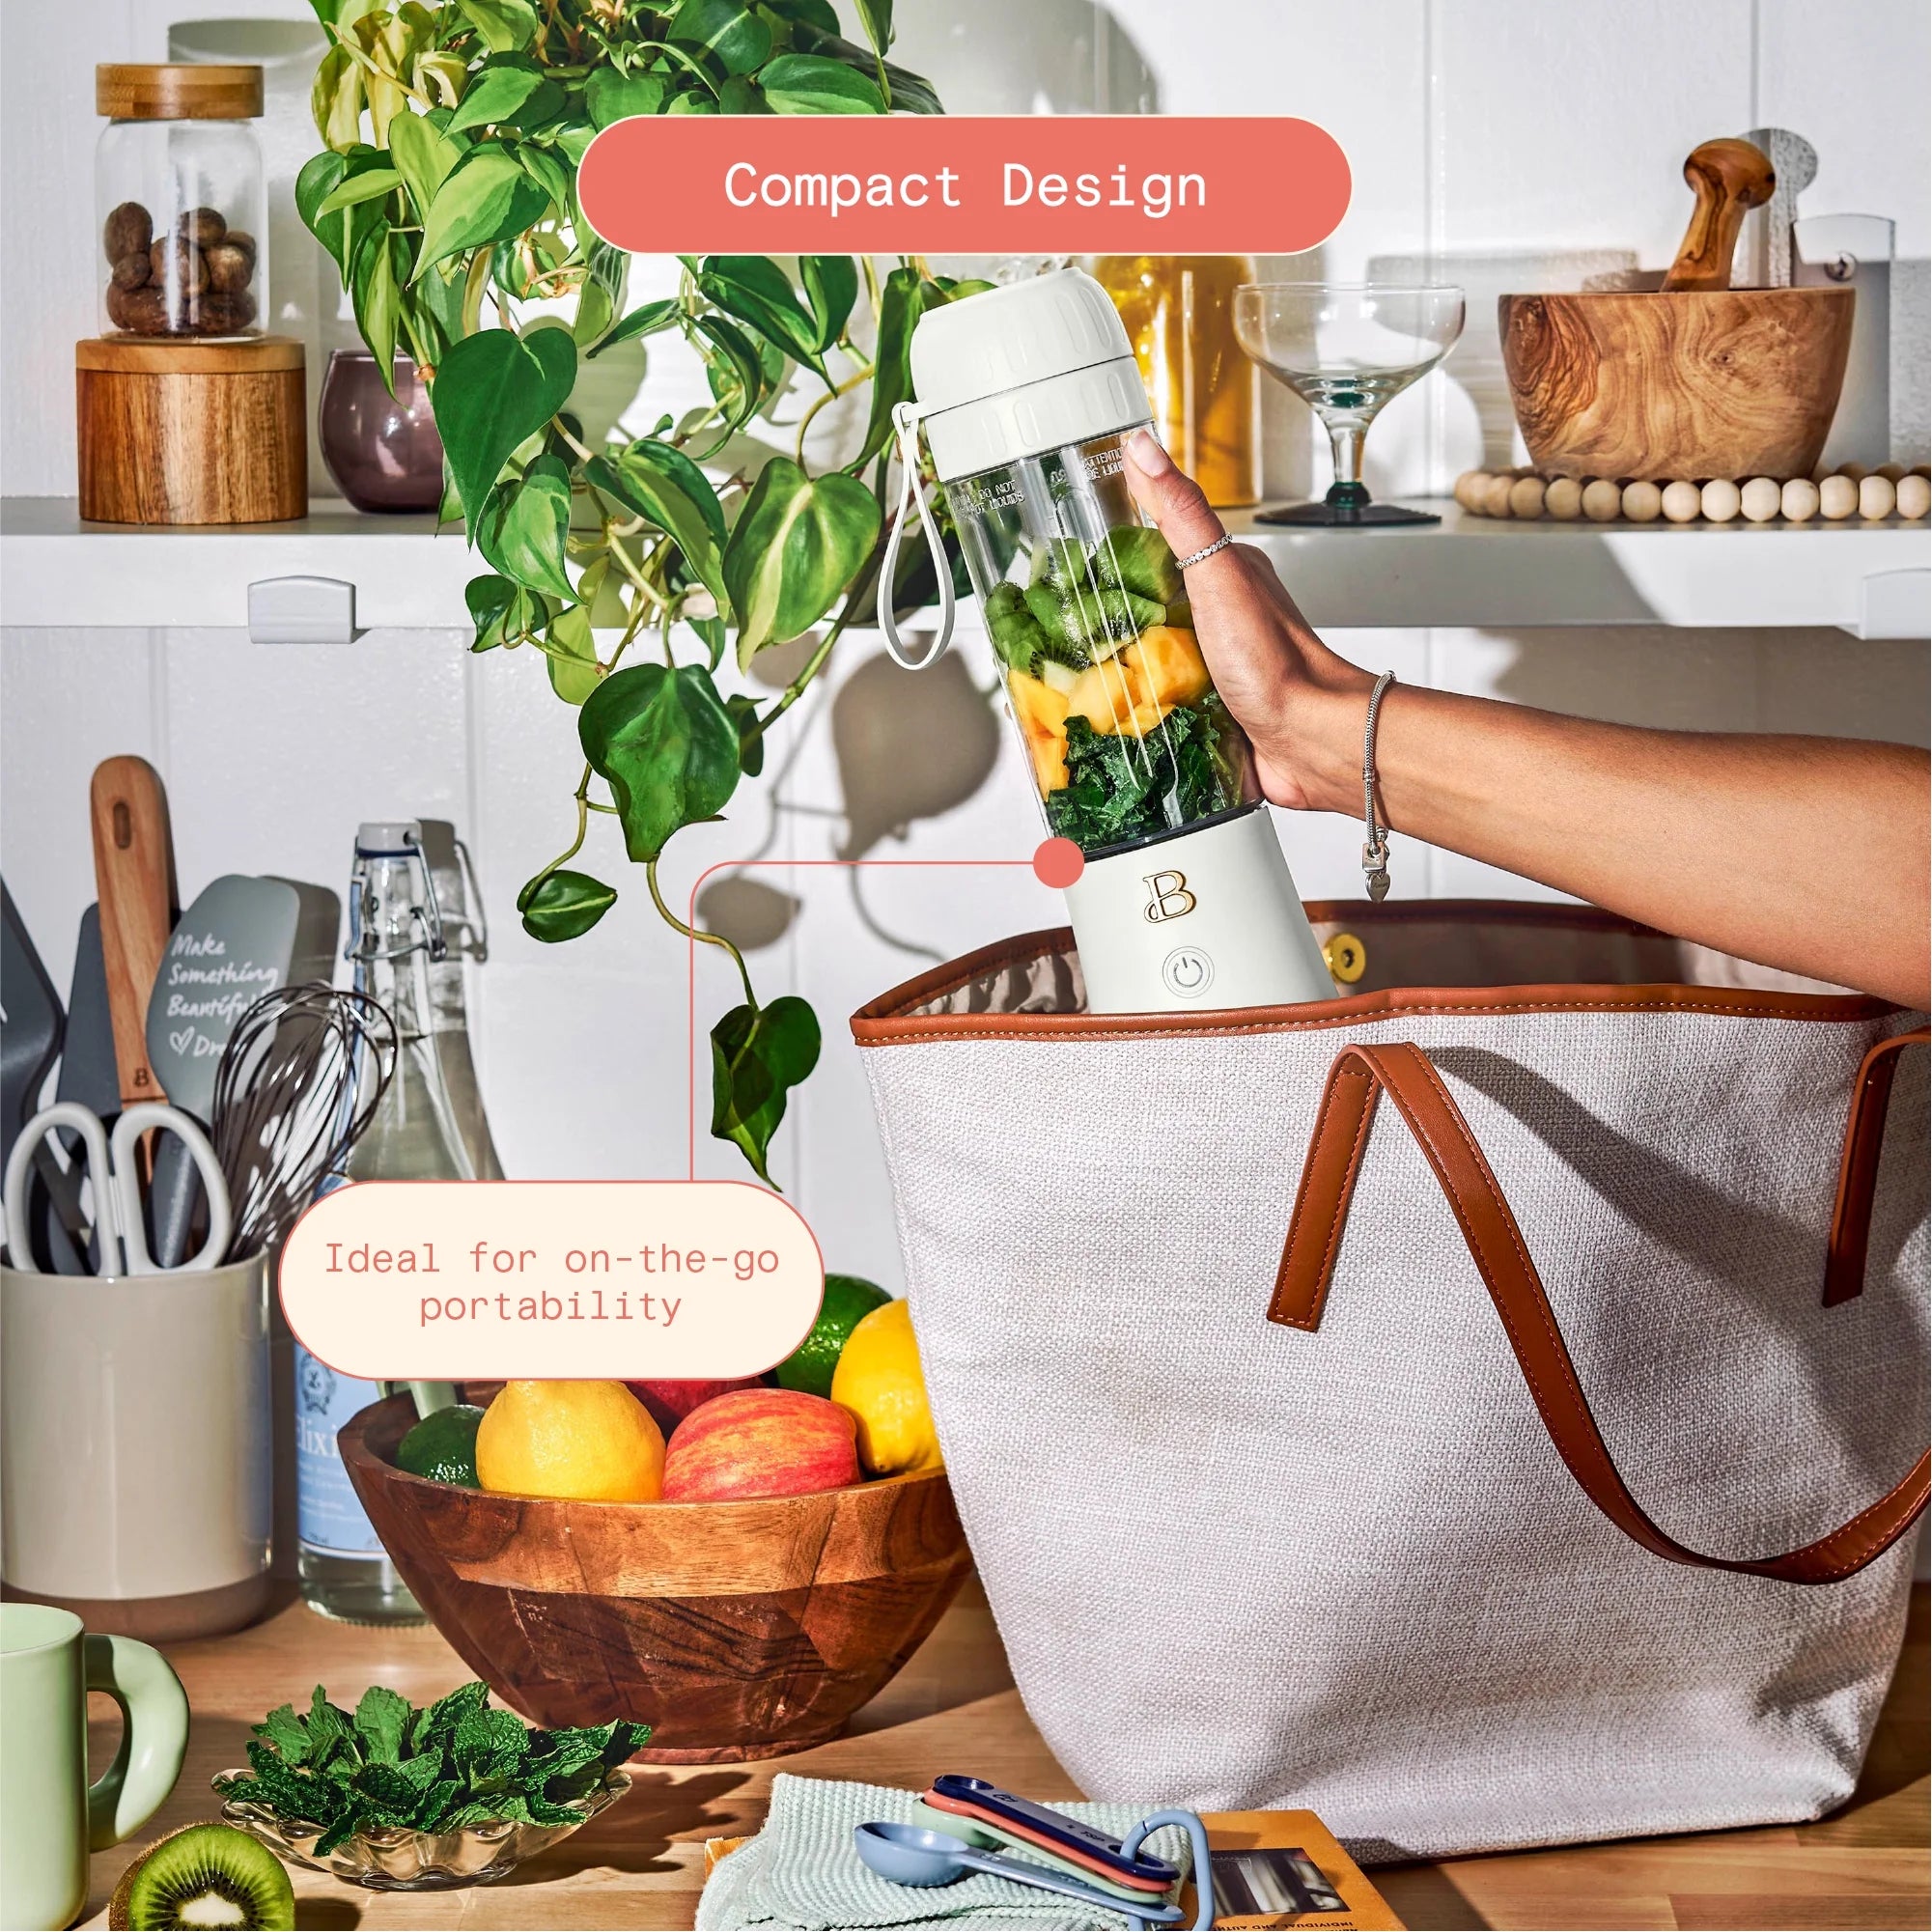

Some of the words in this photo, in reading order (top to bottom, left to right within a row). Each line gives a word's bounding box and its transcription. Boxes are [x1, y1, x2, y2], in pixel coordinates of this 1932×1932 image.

[1142, 870, 1197, 924] B
[171, 933, 226, 957] Make
[167, 961, 279, 994] Something
